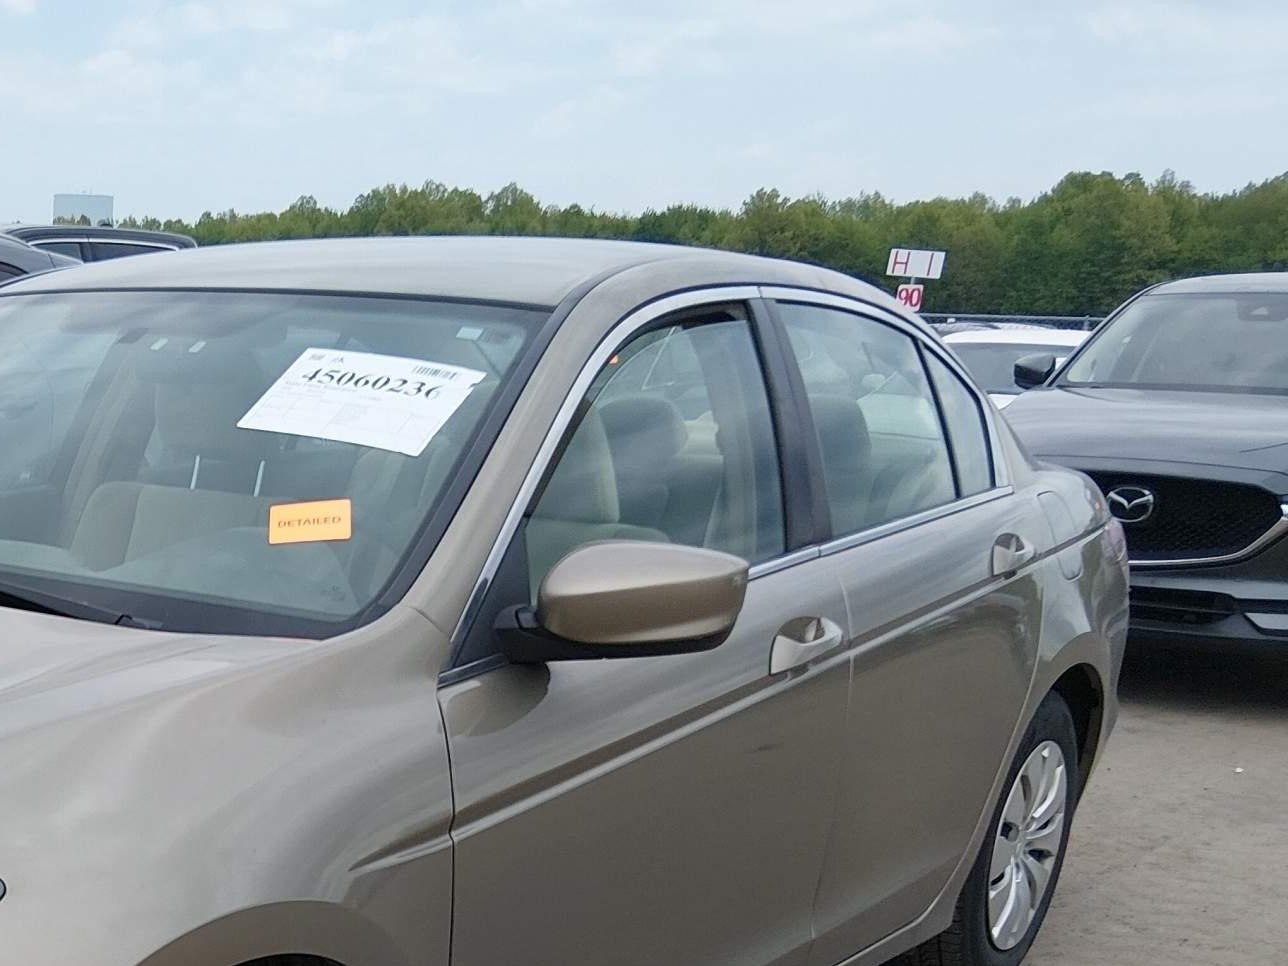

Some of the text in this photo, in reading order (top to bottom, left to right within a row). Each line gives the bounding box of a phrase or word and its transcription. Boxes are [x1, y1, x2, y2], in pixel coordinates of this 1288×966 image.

[891, 250, 911, 275] H
[898, 287, 921, 308] 90
[301, 366, 443, 400] 45060236
[277, 516, 342, 529] DETAILED
